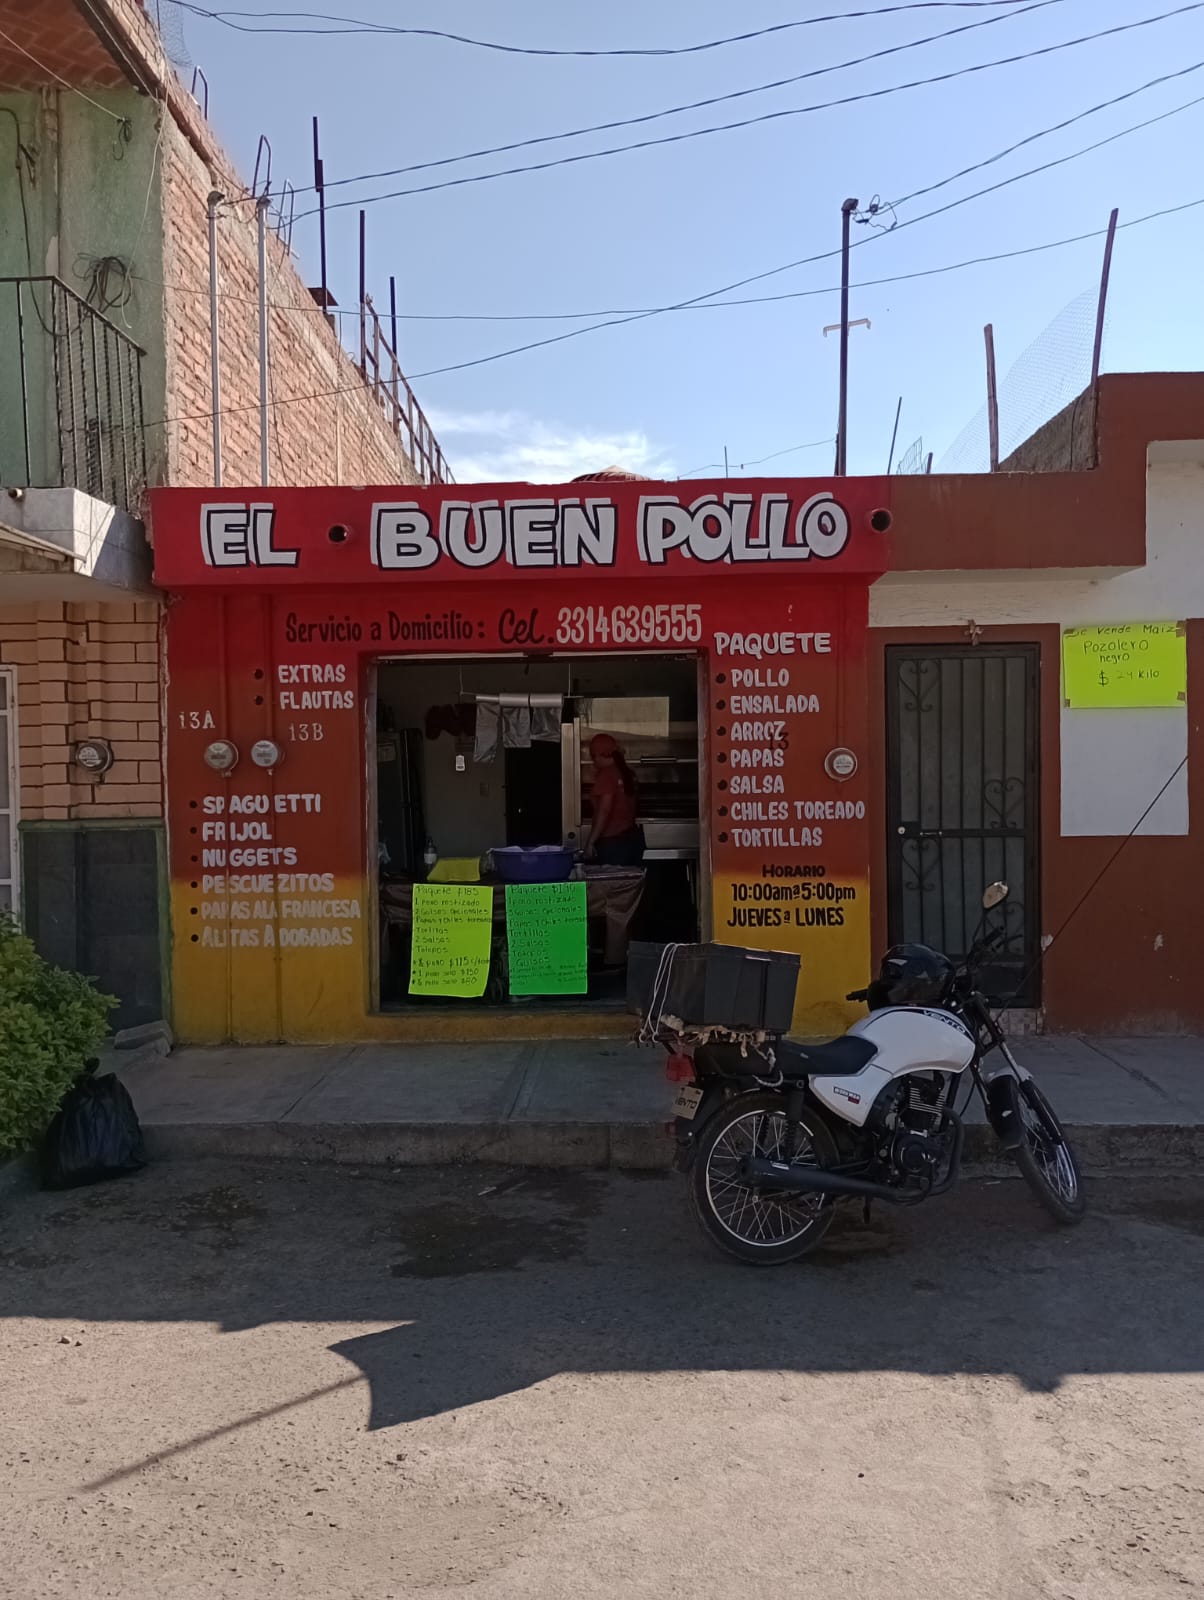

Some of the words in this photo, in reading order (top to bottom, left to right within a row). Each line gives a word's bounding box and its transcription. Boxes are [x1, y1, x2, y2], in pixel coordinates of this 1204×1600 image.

[200, 502, 299, 569] EL
[370, 499, 618, 570] BUEN
[636, 492, 849, 565] POLLO
[286, 612, 362, 643] Servicio
[370, 626, 382, 642] a
[556, 604, 702, 644] 3314639555
[713, 632, 832, 660] PAQUETE
[1100, 653, 1130, 664] negro
[278, 664, 346, 684] EXTRAS
[730, 668, 790, 688] POLLO
[279, 691, 354, 710] FLAUTAS
[730, 694, 820, 715] ENSALADA
[179, 710, 216, 729] 13A
[289, 723, 324, 742] 13B
[730, 721, 786, 742] ARROZ
[730, 749, 785, 768] PAPAS
[730, 775, 785, 794] SALSA
[730, 801, 789, 820] CHILES
[794, 800, 866, 820] TOREADO
[731, 827, 823, 847] TORTILLAS
[202, 847, 298, 868] NUGGETS
[761, 864, 826, 878] HORARIO
[202, 873, 335, 894] PESCUEZITOS
[727, 907, 782, 927] JUEVES
[795, 907, 845, 927] LUNES
[923, 1010, 966, 1034] VENTO
